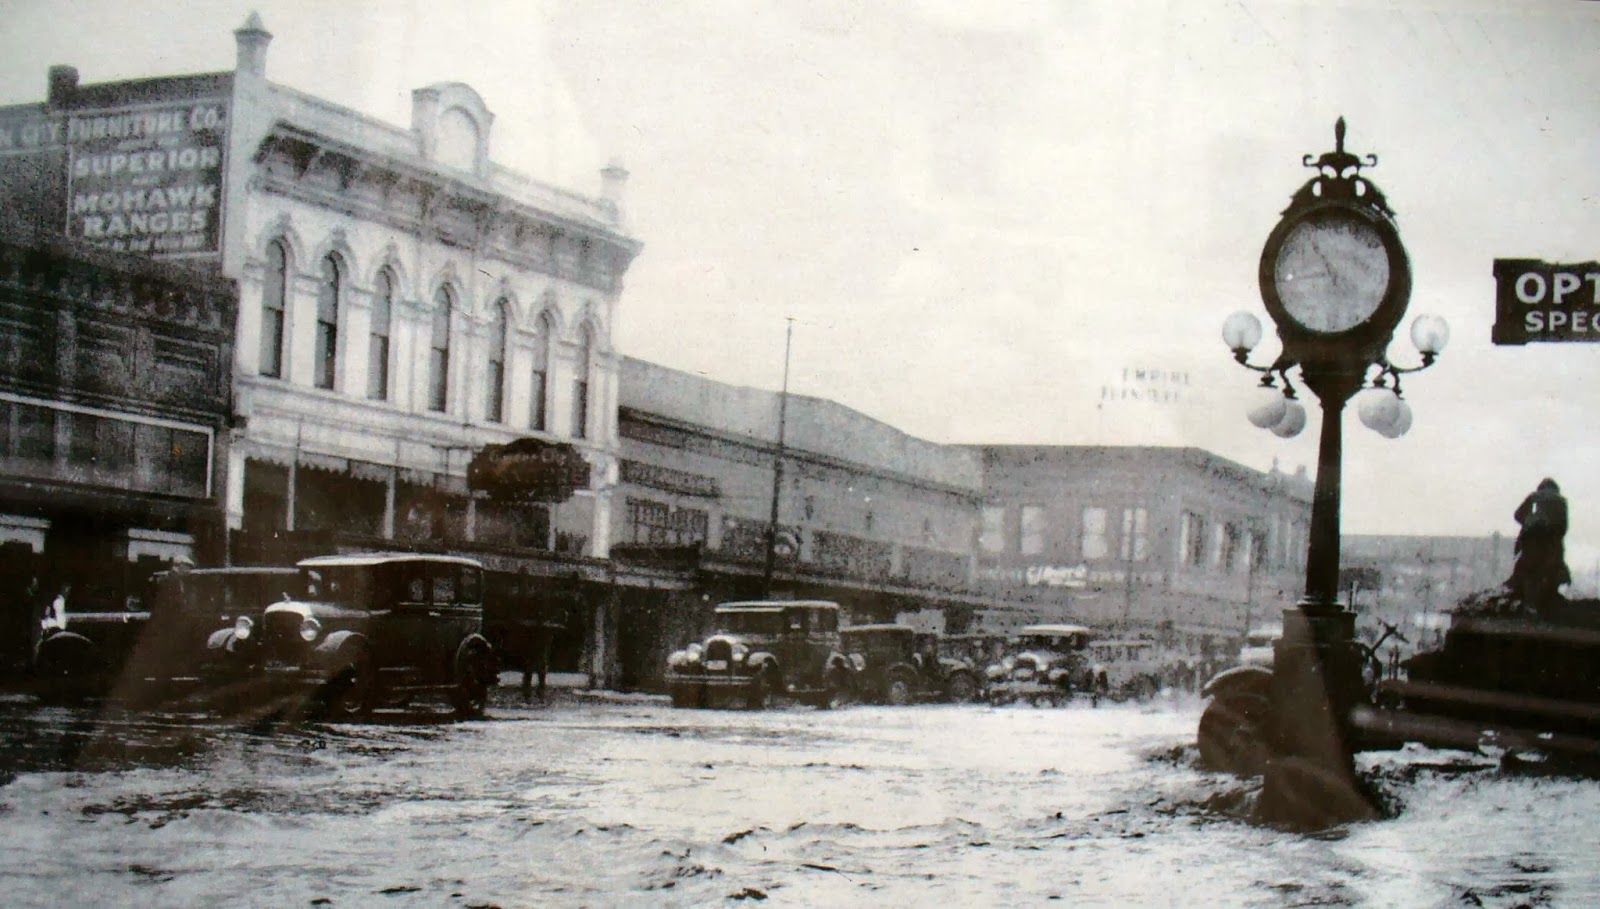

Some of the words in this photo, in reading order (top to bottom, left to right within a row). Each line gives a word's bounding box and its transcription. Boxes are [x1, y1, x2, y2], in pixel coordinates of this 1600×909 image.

[75, 148, 219, 176] SUPERIOR
[74, 185, 215, 213] MOHAWK
[83, 210, 207, 238] RANGES
[1515, 271, 1600, 305] OPT
